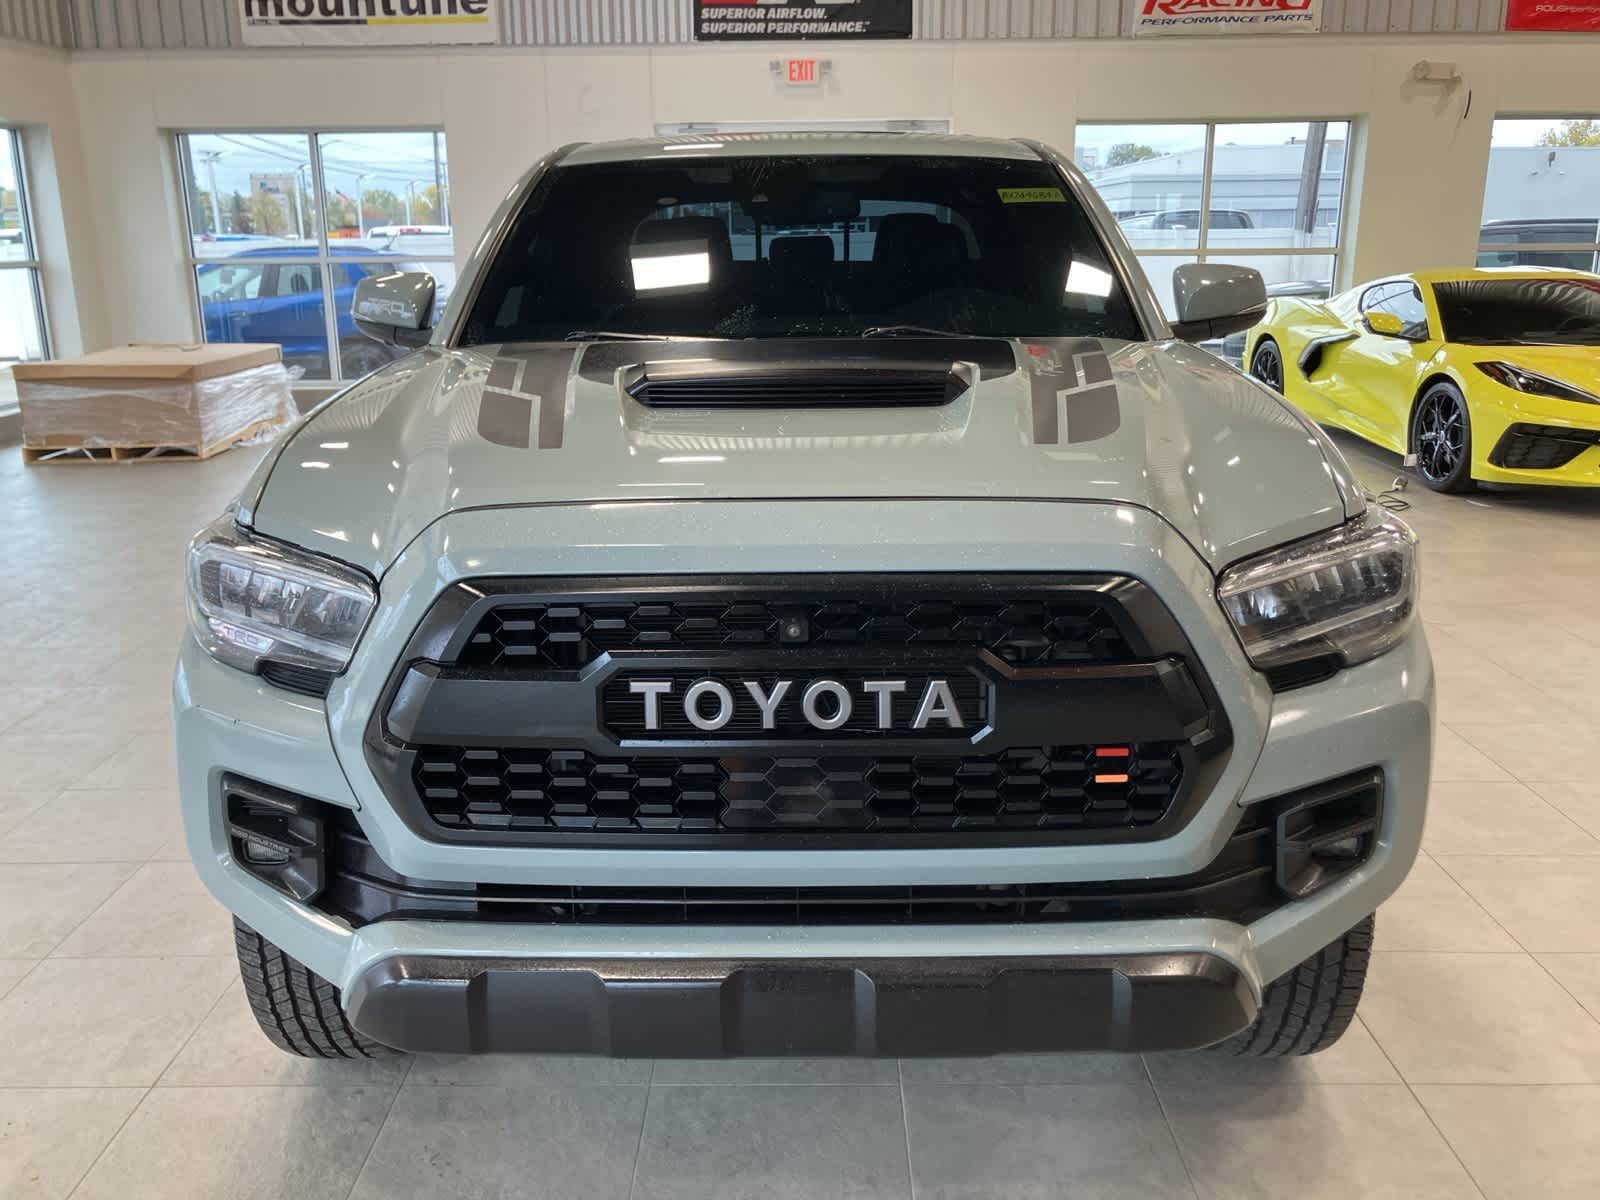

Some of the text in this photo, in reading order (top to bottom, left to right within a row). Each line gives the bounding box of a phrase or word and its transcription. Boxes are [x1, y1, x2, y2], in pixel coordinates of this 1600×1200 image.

[701, 7, 828, 19] SUPERIOR AIRFLOW.
[1140, 14, 1313, 25] PERFORMANCE PARTS
[701, 22, 765, 34] SUPERIOR
[789, 60, 815, 81] EXIT
[629, 679, 965, 731] TOYOTA
